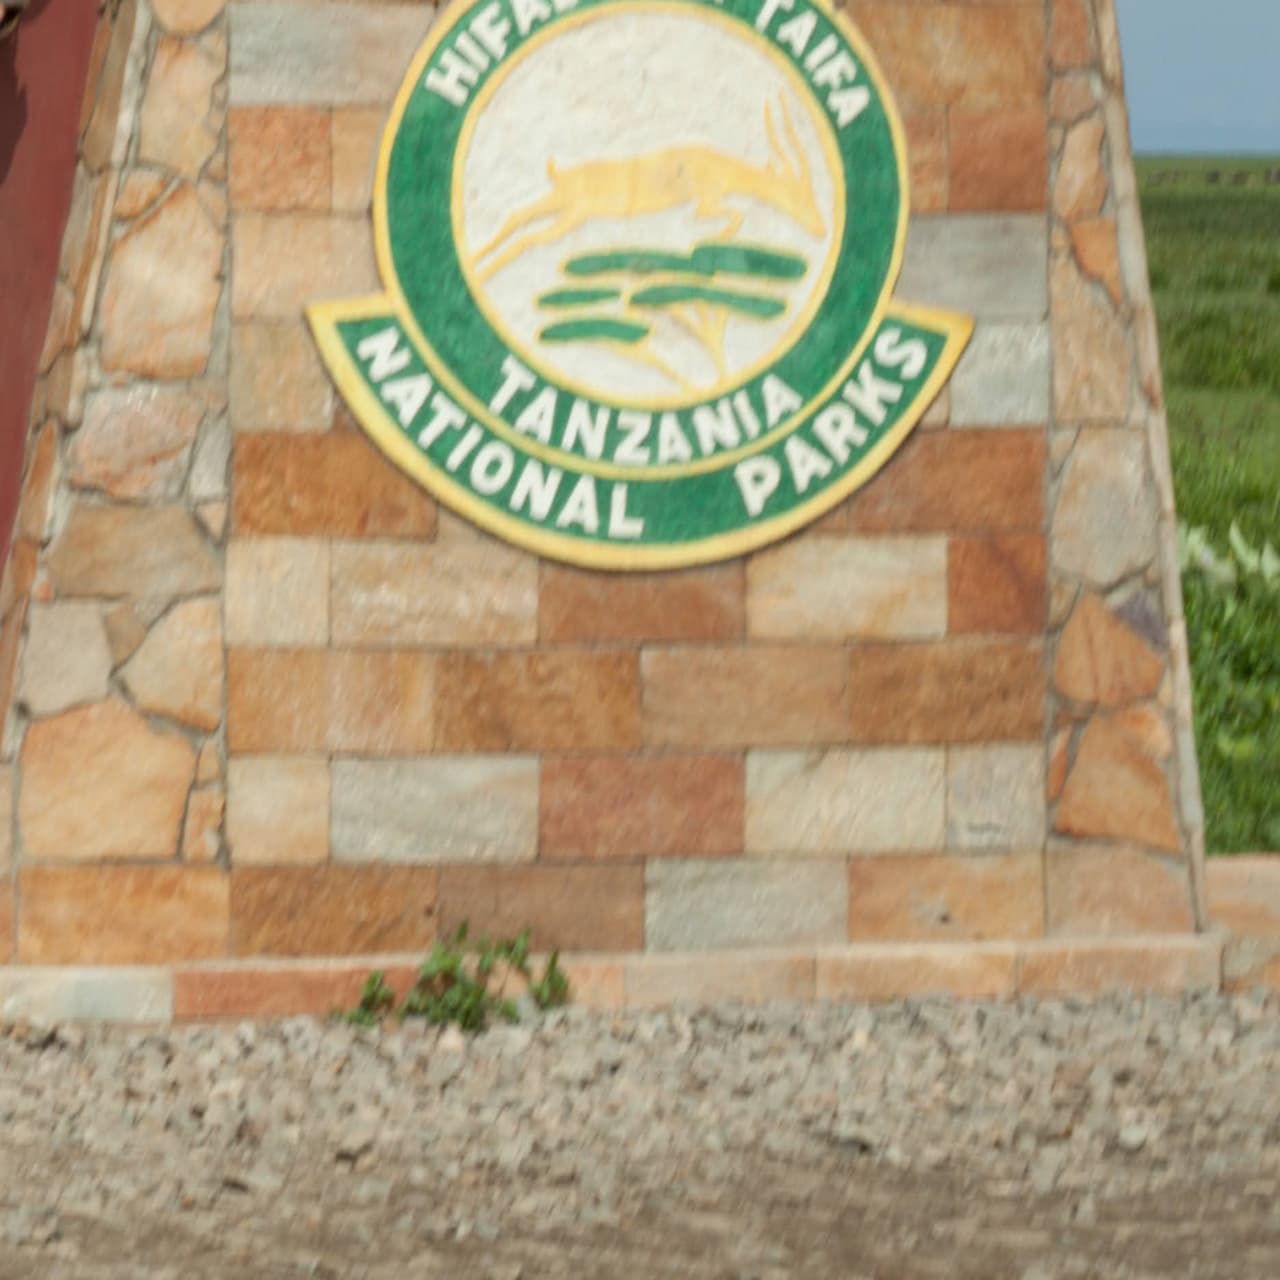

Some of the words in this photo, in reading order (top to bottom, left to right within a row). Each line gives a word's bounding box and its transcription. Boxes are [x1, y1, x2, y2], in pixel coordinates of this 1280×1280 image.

[356, 325, 646, 540] NATIONAL
[733, 327, 929, 519] PARKS
[488, 353, 803, 466] TANZANIA
